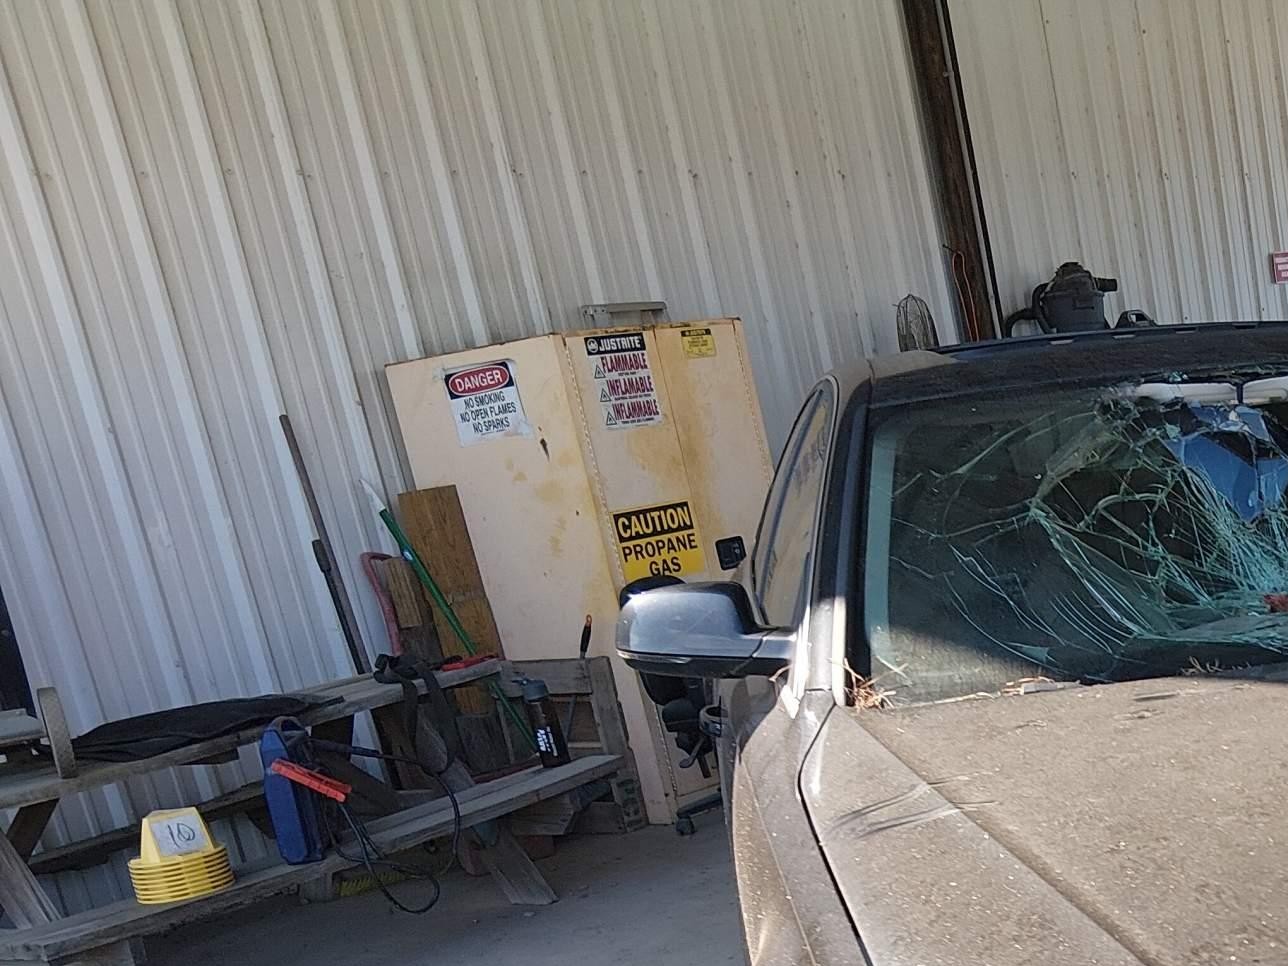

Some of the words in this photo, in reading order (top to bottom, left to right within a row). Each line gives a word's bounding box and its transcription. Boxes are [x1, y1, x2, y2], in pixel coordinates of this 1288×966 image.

[599, 335, 641, 352] JUSTRITE
[600, 352, 649, 373] FLAMMABLE
[454, 369, 503, 392] DANGER
[607, 375, 654, 397] INFLAMABLE
[464, 398, 475, 410] NO
[474, 391, 506, 407] SMOKING
[612, 399, 660, 420] INFLAMMABLE
[460, 412, 471, 423] NO
[471, 406, 490, 421] OPEN
[489, 401, 517, 418] FLAMES
[472, 421, 484, 433] NO
[483, 416, 510, 432] SPARKS
[617, 506, 691, 538] CAUTION
[621, 533, 698, 563] PROPANE
[649, 556, 682, 577] GAS
[167, 822, 196, 849] 10
